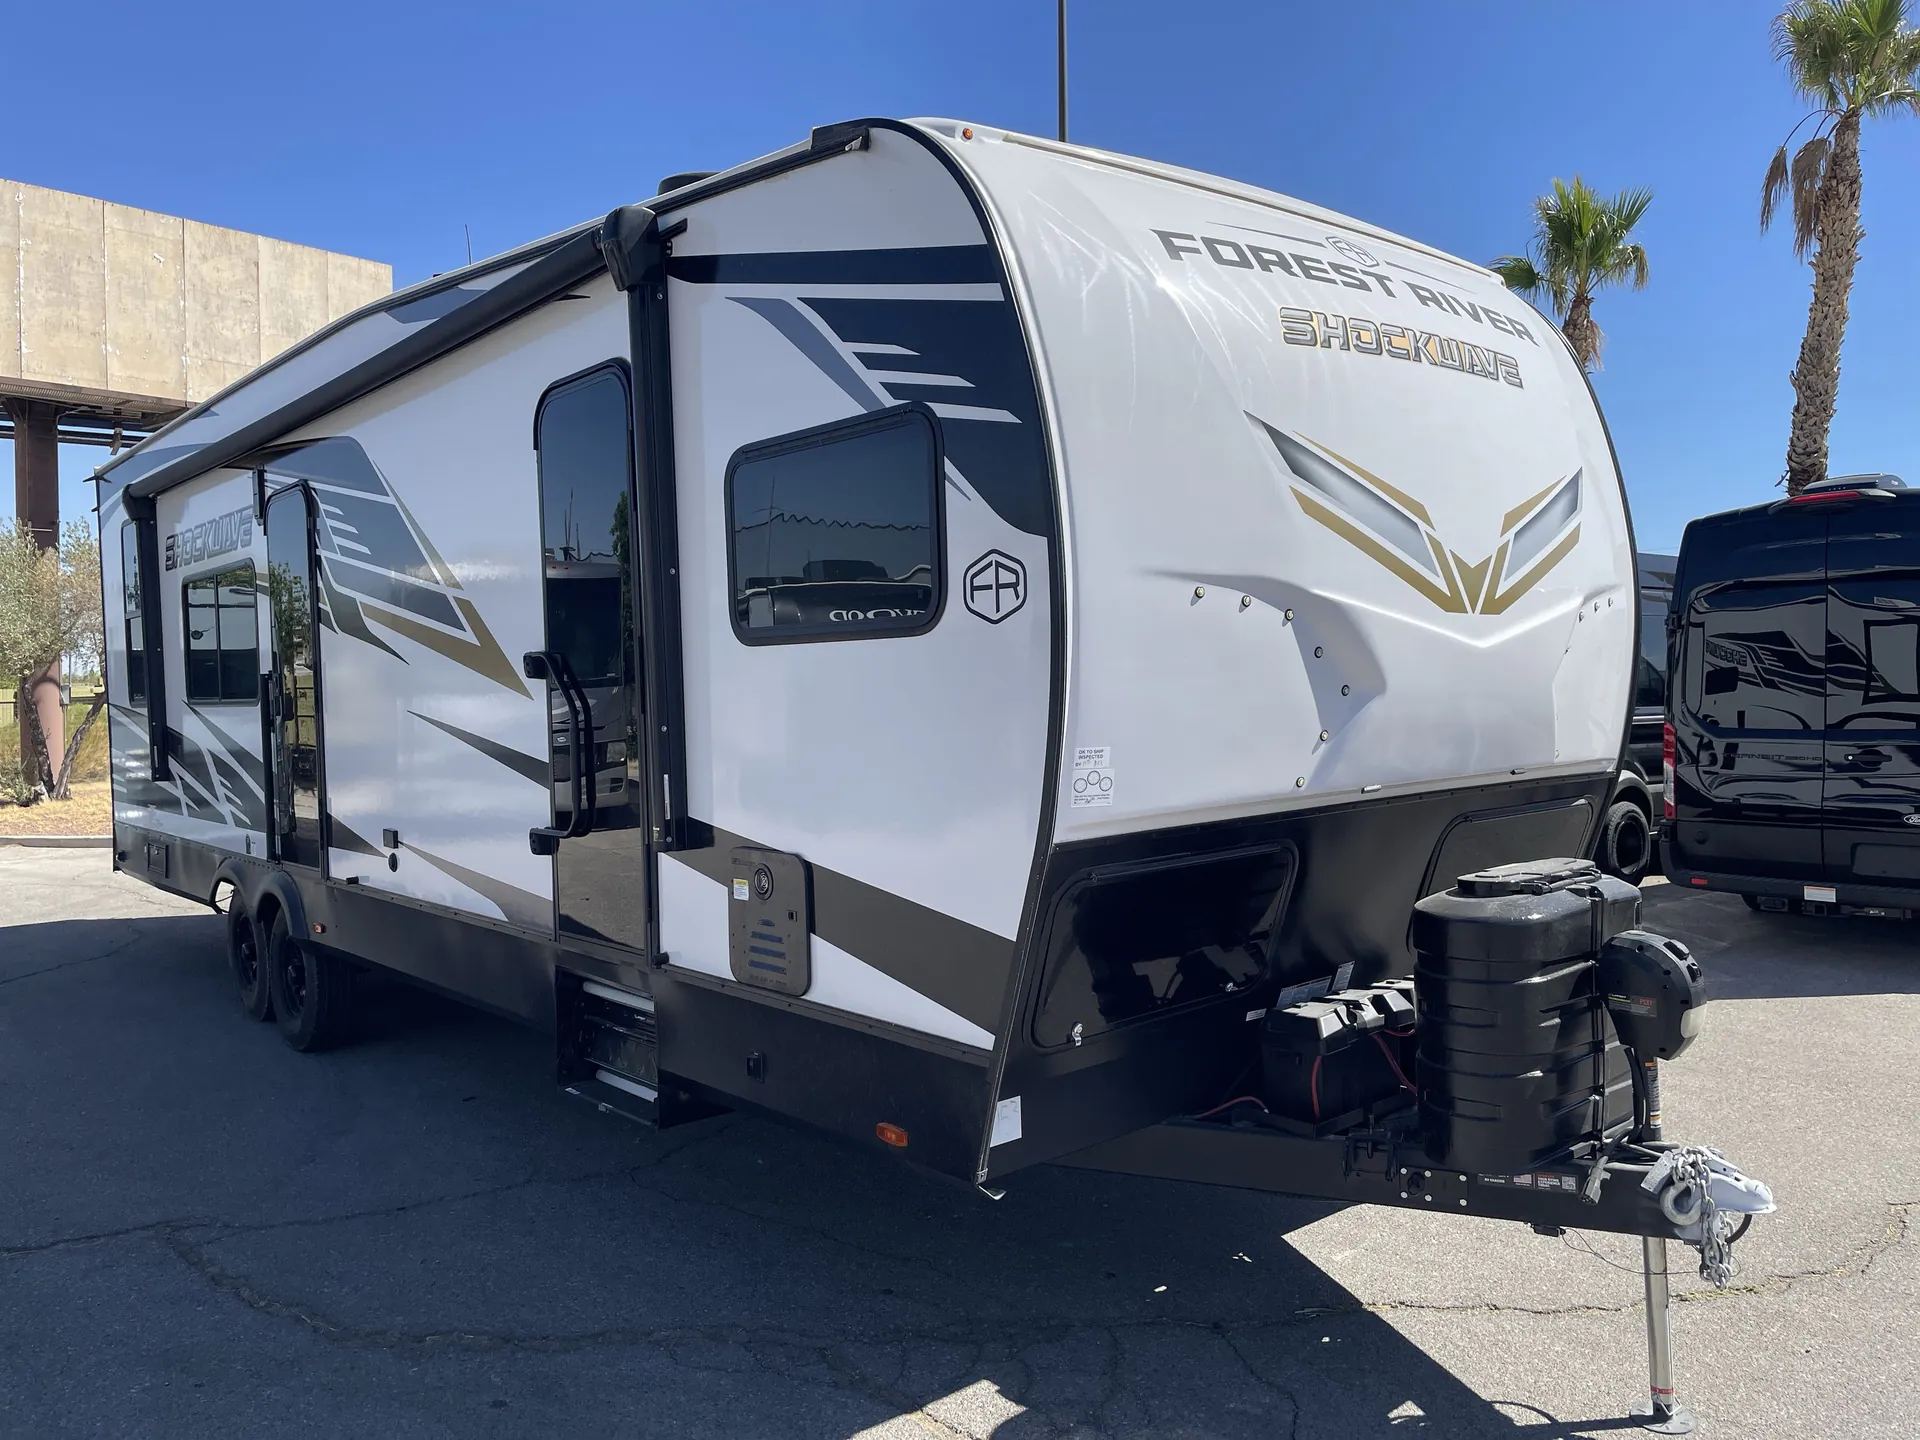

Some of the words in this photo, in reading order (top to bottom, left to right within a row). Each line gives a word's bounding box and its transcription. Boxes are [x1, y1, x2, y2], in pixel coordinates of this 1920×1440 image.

[1151, 228, 1397, 299] FOREST
[1402, 280, 1540, 348] RIVER
[1279, 306, 1524, 390] SHOCKWAVE
[165, 504, 254, 572] SHOCKWAVE
